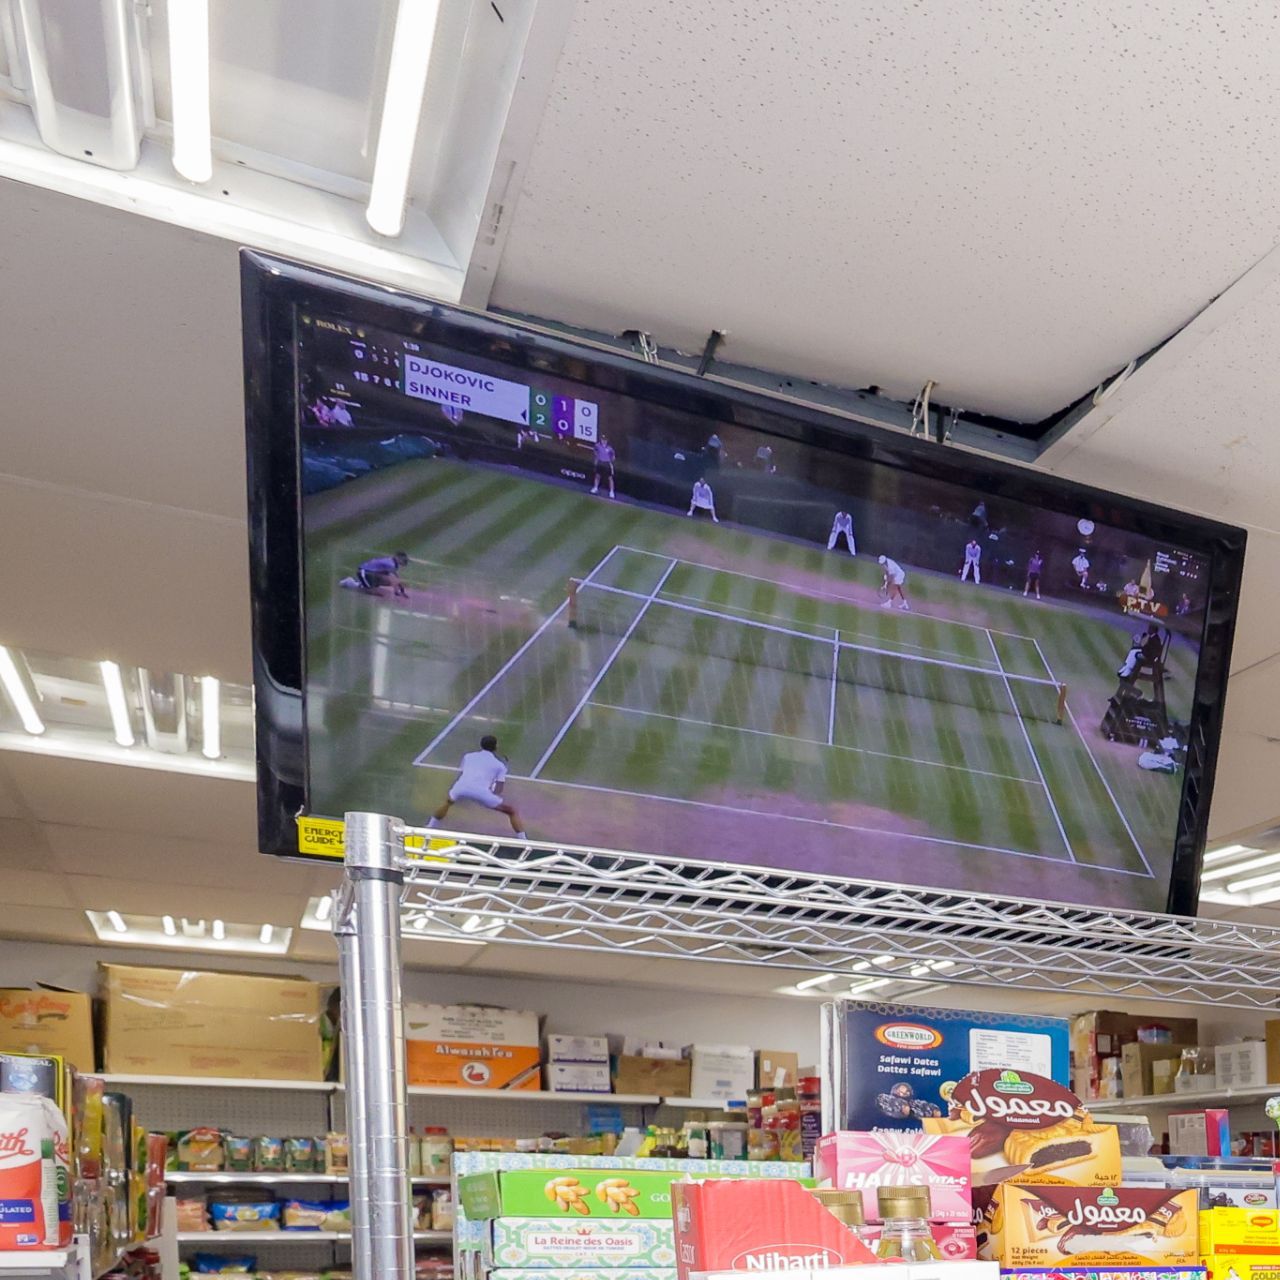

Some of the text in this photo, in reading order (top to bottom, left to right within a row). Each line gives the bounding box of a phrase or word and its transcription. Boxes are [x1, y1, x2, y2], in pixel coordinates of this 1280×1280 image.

[409, 361, 495, 392] DJOKOVIC
[535, 394, 546, 406] 0
[581, 406, 591, 417] 0
[409, 382, 593, 437] SINNER 2 0 15
[880, 1055, 939, 1066] Safawi Dates
[878, 1065, 941, 1077] Dattes Safawi
[928, 1176, 968, 1186] VITA-C
[1067, 1198, 1146, 1226] معمول
[534, 1237, 633, 1247] La Reine des Oasis
[1023, 1247, 1048, 1257] pieces
